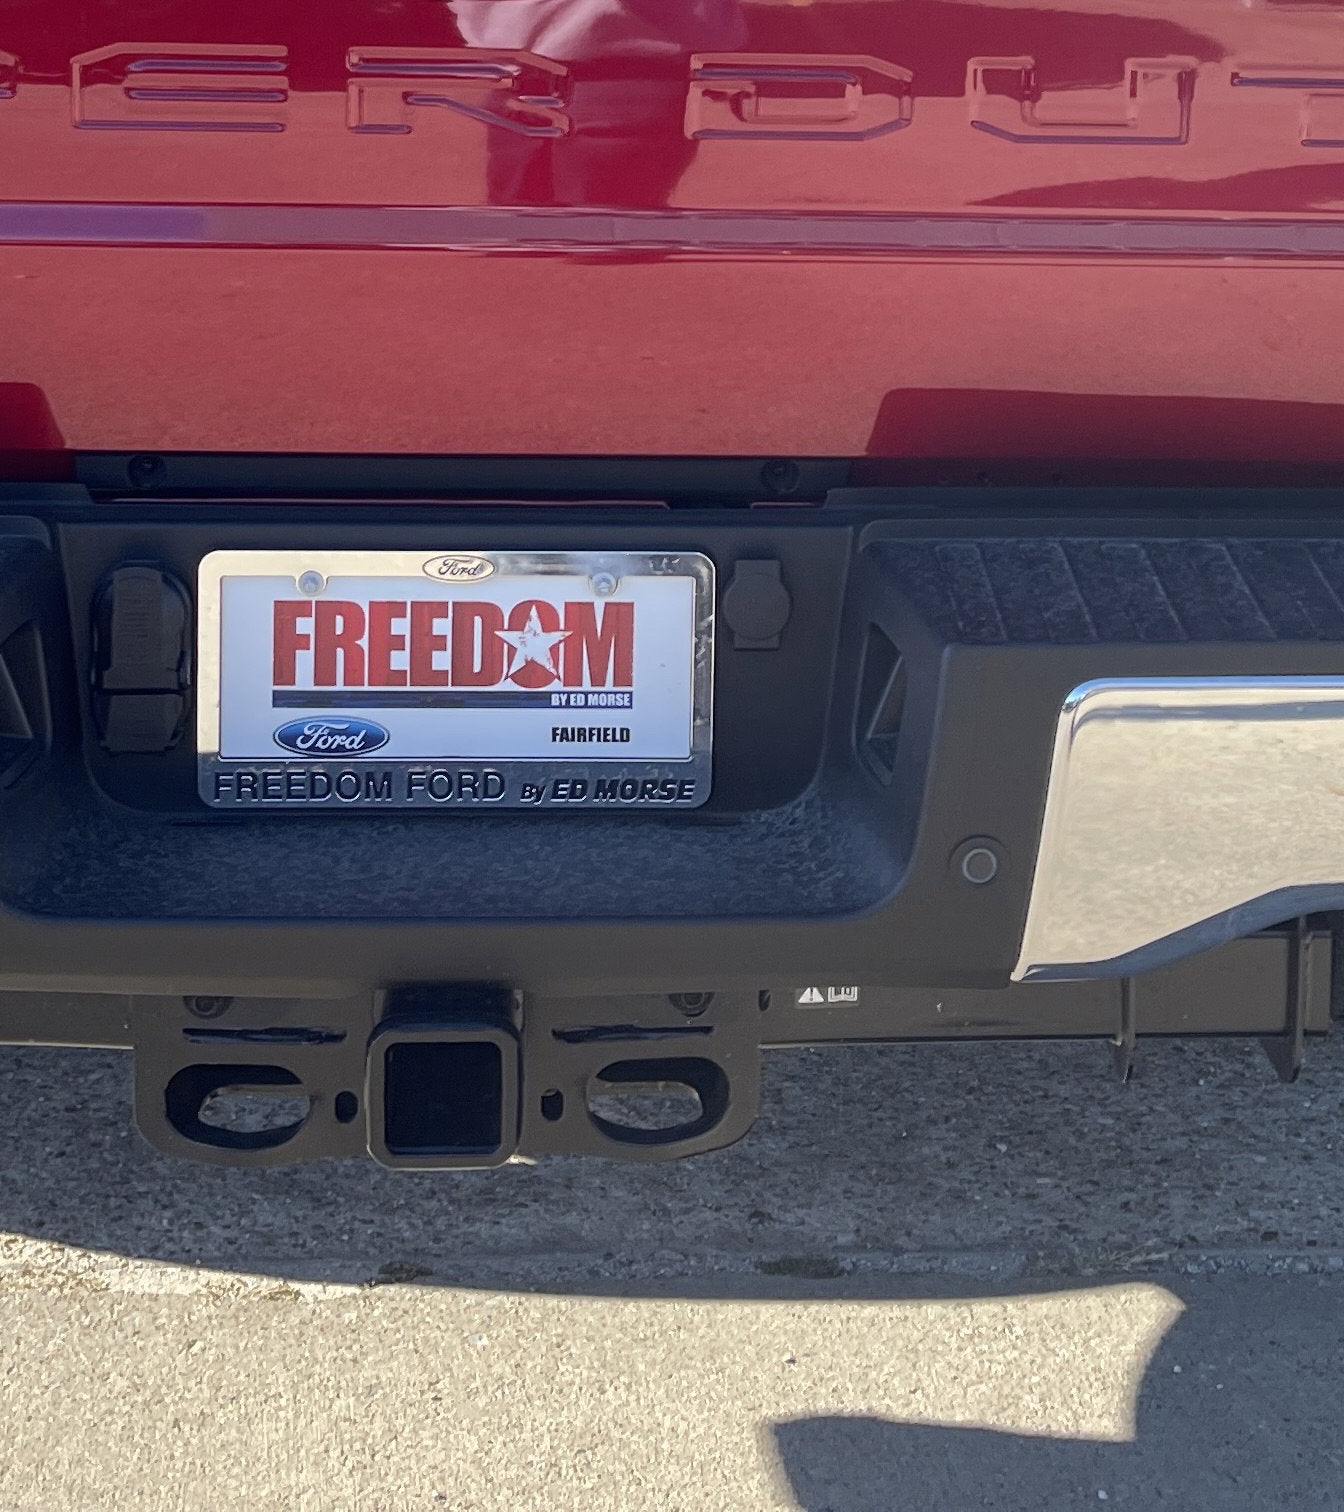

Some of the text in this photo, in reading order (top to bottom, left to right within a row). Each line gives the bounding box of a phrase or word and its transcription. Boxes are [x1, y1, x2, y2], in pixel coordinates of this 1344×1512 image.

[438, 558, 482, 576] Ford
[272, 599, 635, 688] FREEDOM
[551, 693, 631, 707] BY ED MORSE
[296, 721, 367, 750] Ford
[551, 726, 631, 743] FAIRFIELD
[214, 769, 393, 803] FREEDOM
[406, 769, 506, 803] FORD
[550, 779, 588, 803] ED
[593, 778, 696, 804] MORSE
